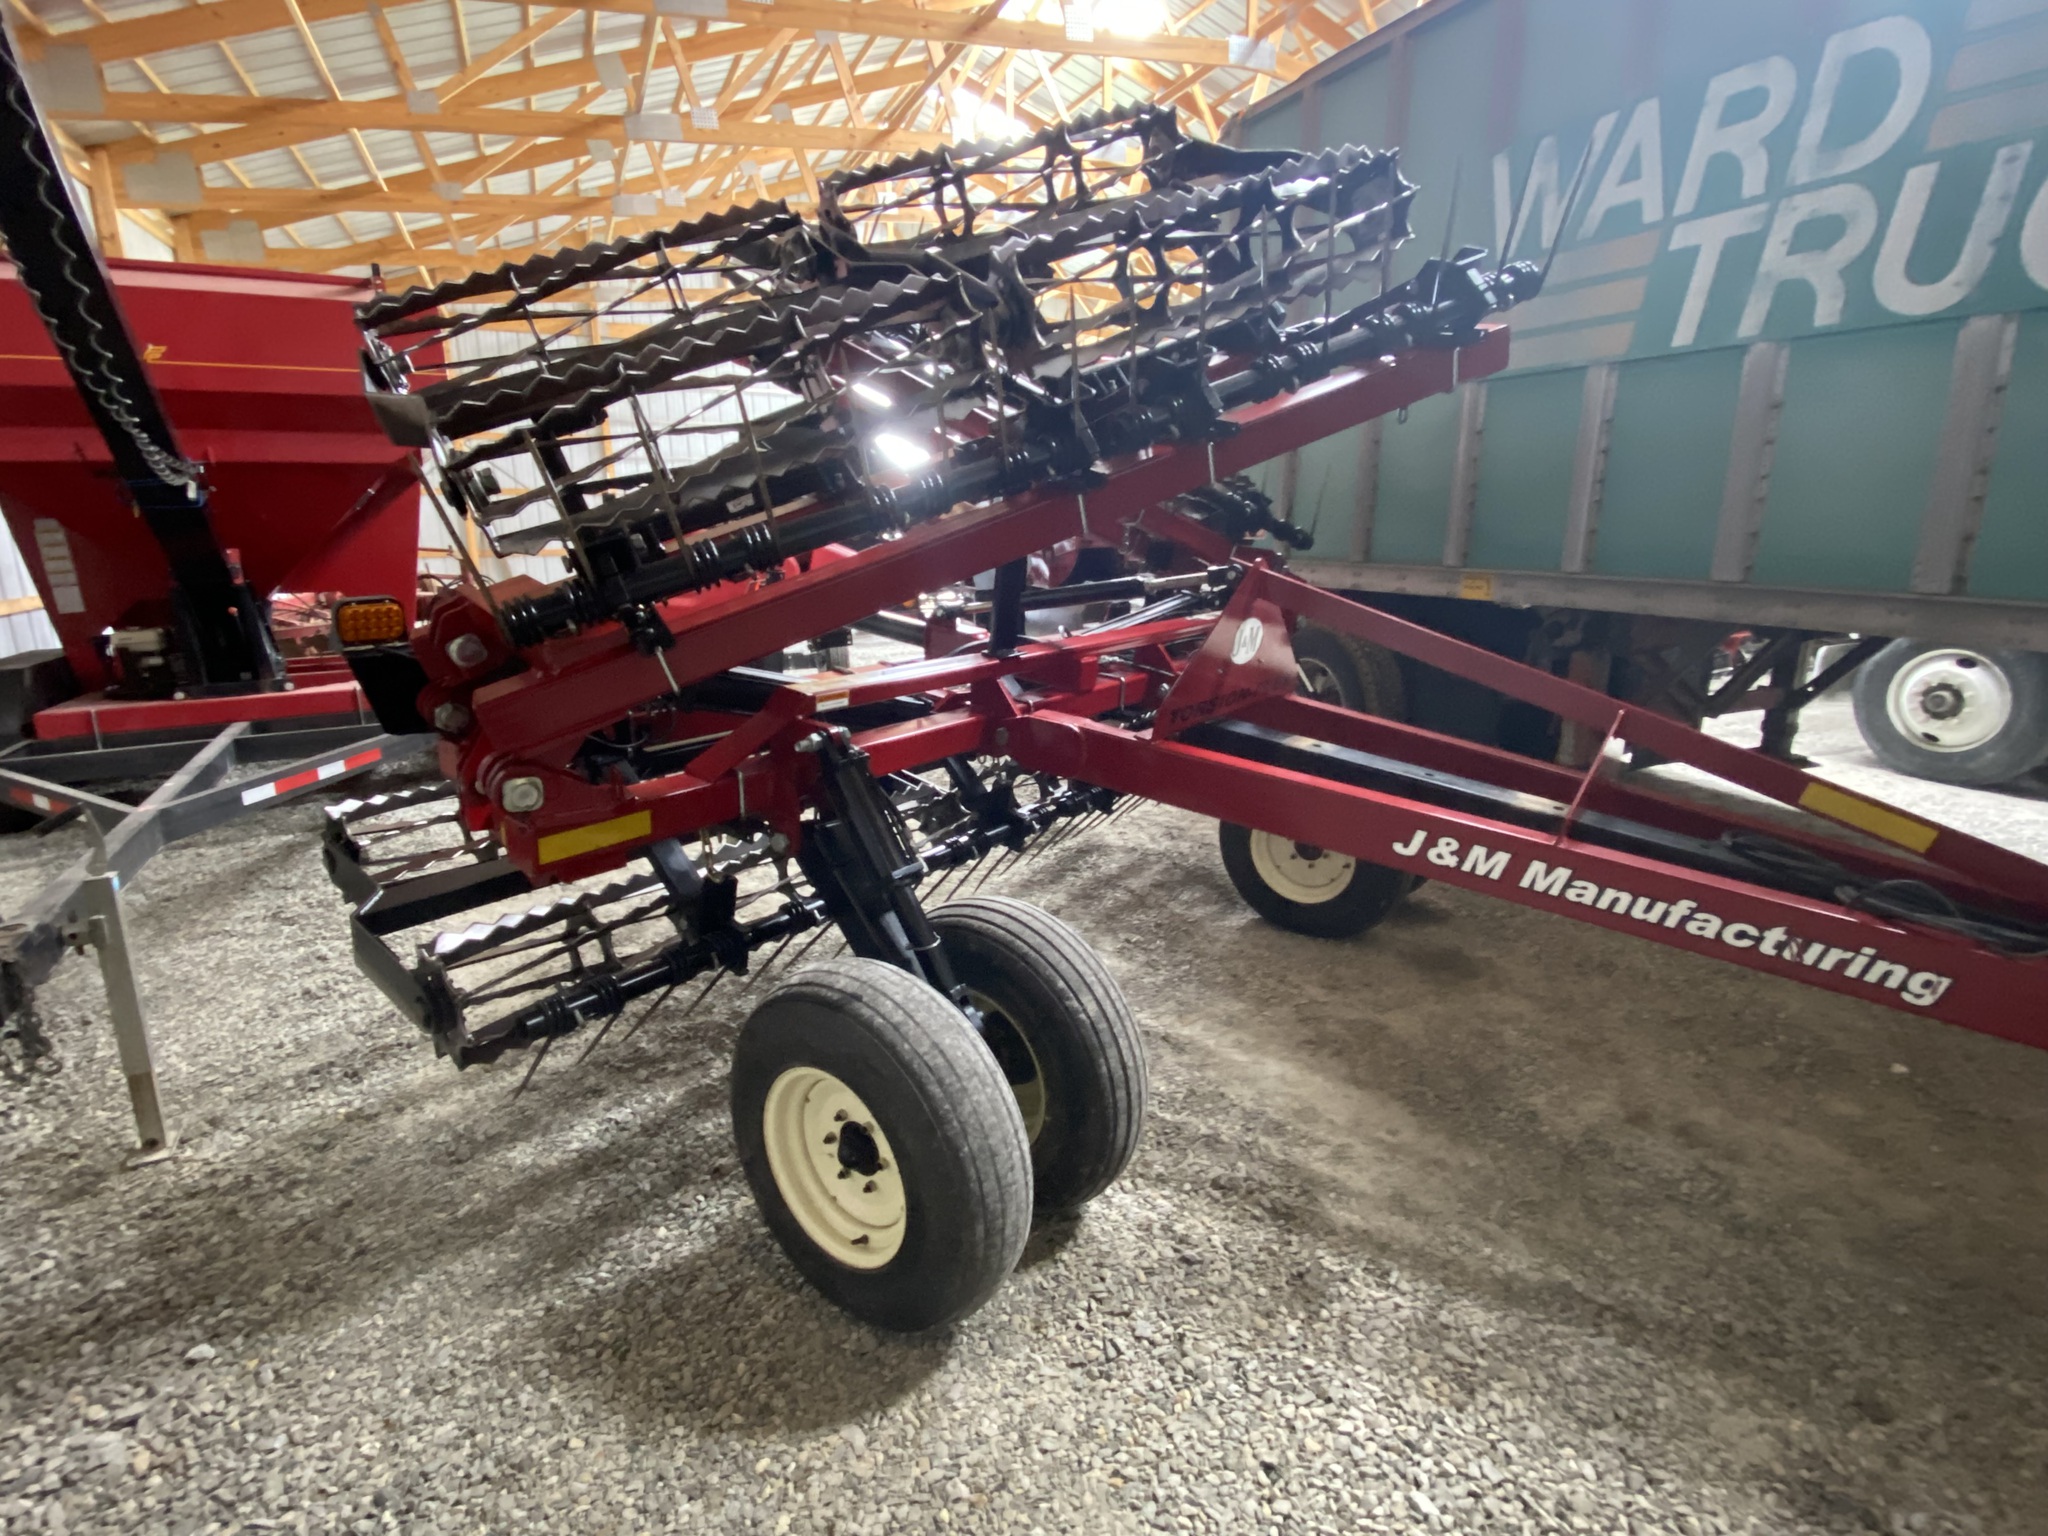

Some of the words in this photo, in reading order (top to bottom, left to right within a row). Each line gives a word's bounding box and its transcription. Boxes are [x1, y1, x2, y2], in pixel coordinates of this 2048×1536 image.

[1493, 15, 1931, 260] WARD
[1668, 139, 2048, 347] TRU
[1393, 829, 1511, 881] J&M
[1518, 860, 1951, 1006] Manufacturing
